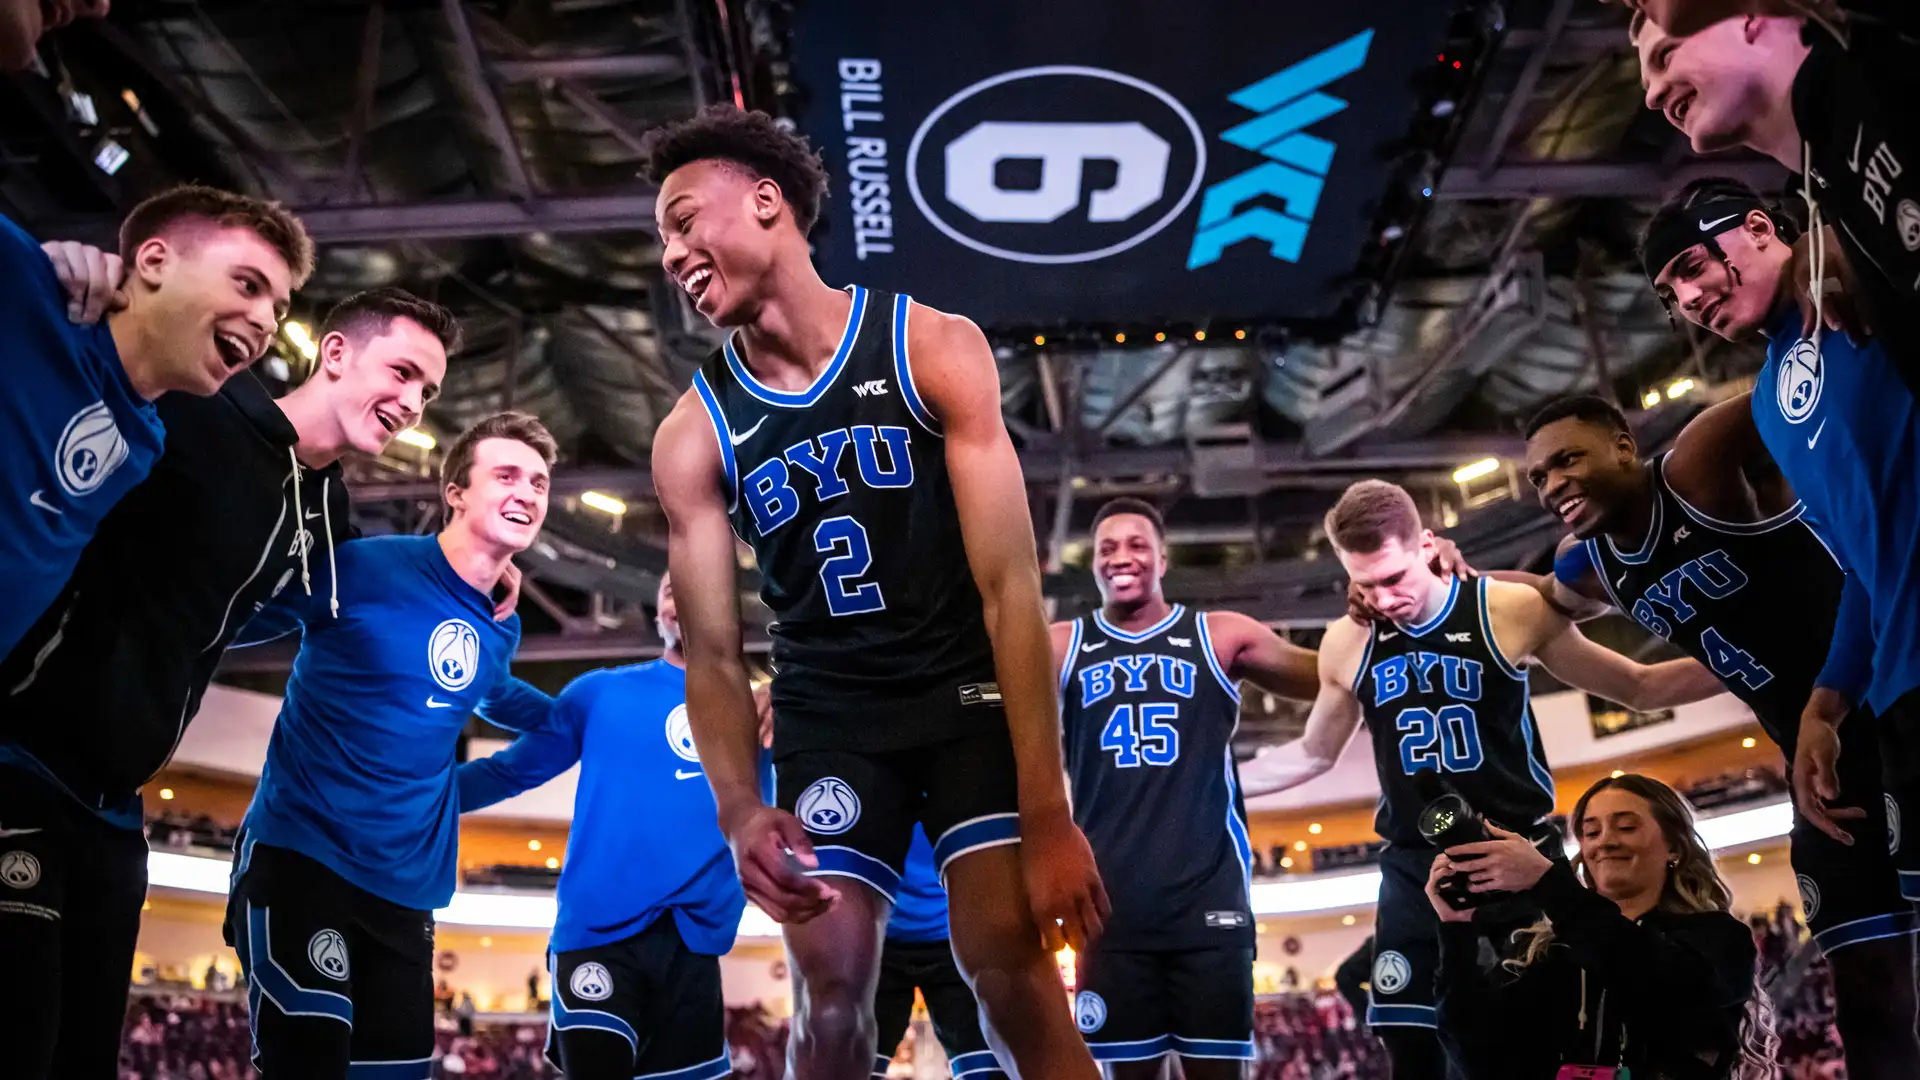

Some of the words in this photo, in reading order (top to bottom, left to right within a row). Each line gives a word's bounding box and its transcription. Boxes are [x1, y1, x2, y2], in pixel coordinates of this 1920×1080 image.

[838, 58, 885, 132] BILL
[845, 136, 895, 261] RUSSELL
[944, 121, 1171, 224] 6
[1863, 141, 1902, 226] BYU
[851, 379, 889, 398] WCC
[743, 425, 914, 537] BYU
[813, 515, 886, 616] 2
[1631, 549, 1749, 643] BYU
[1078, 653, 1198, 709] BYU
[1372, 651, 1484, 707] BYU
[1700, 626, 1775, 691] 4
[1100, 702, 1179, 768] 45
[1396, 703, 1484, 776] 20
